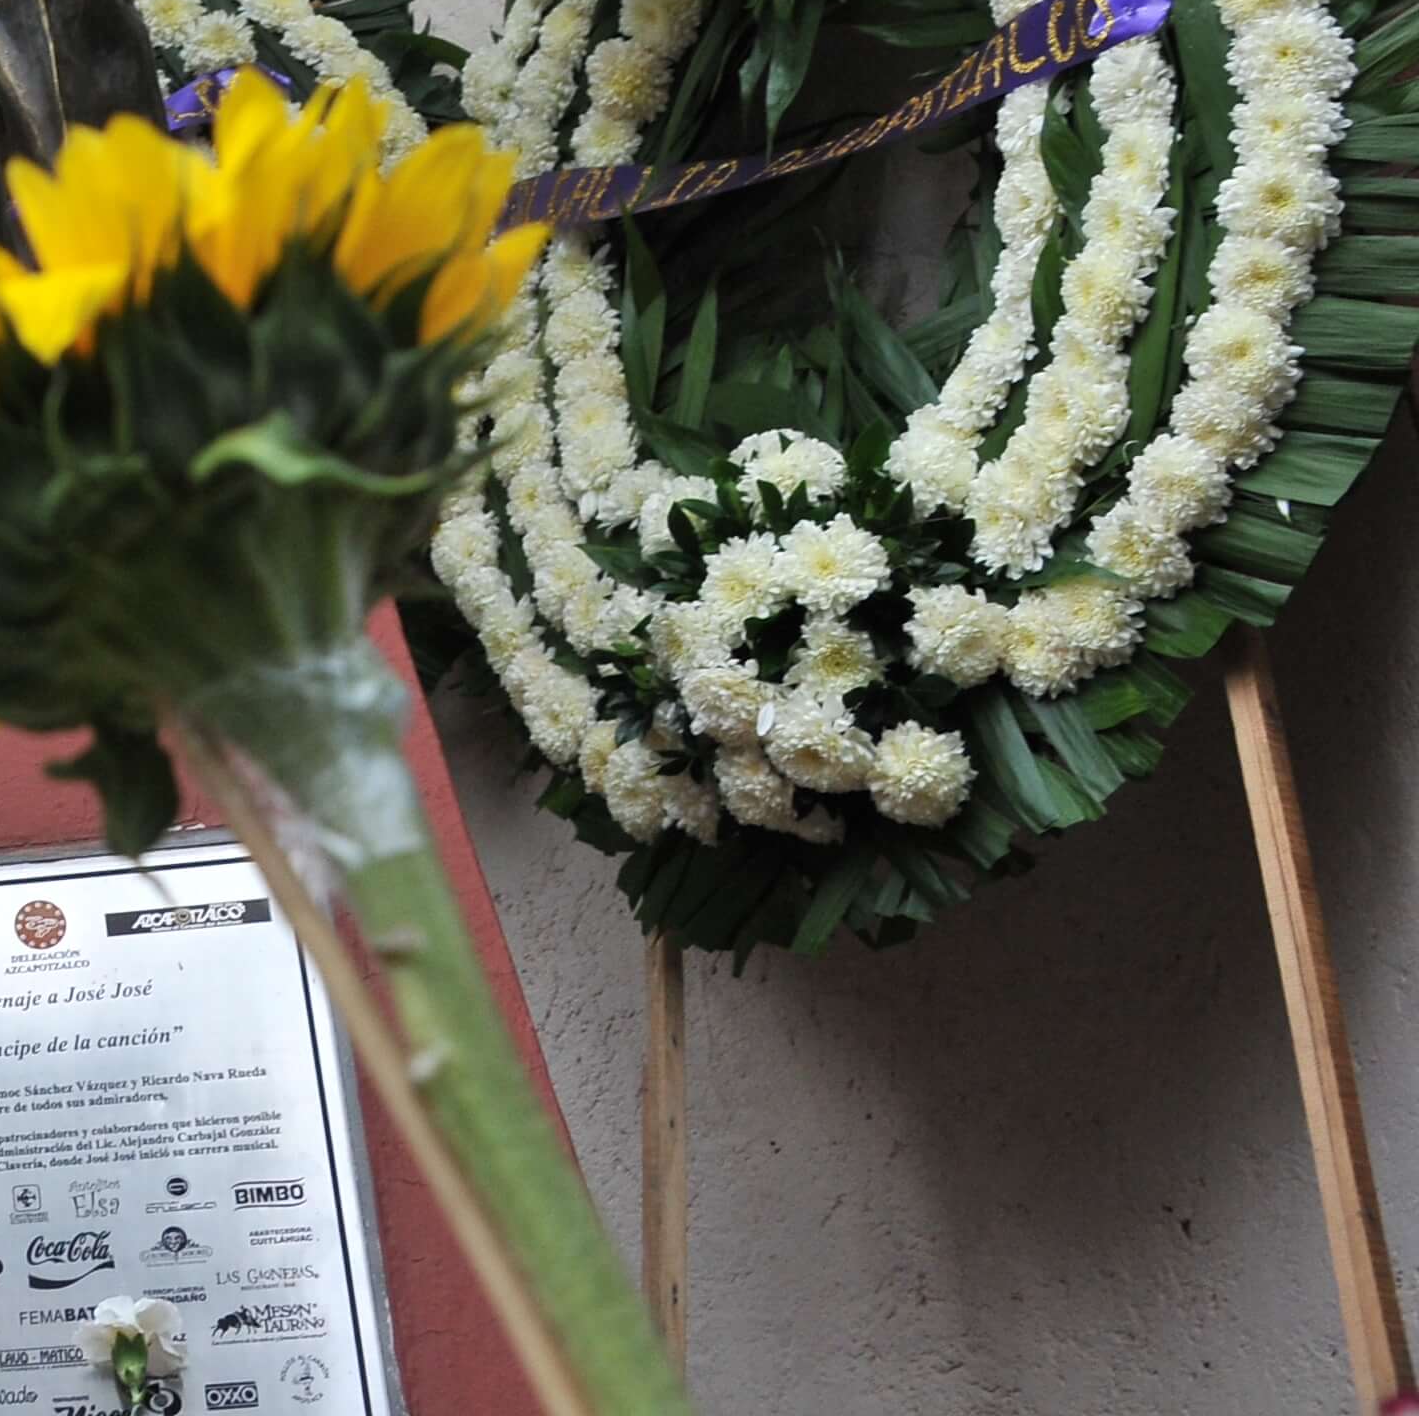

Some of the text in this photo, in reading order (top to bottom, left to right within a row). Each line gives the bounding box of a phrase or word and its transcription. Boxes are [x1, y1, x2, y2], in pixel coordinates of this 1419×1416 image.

[47, 993, 59, 1004] a
[64, 983, 106, 1004] José
[110, 979, 153, 1000] José
[46, 1036, 69, 1054] de
[73, 1034, 91, 1051] la
[24, 1083, 73, 1098] Sánchez
[76, 1080, 128, 1094] Vázquez
[130, 1078, 138, 1090] y
[141, 1072, 190, 1088] Ricardo
[193, 1070, 225, 1083] Nava
[227, 1066, 267, 1080] Rueda
[13, 1101, 28, 1113] de
[31, 1098, 64, 1112] todos
[66, 1098, 86, 1110] sus
[81, 1126, 88, 1138] y
[91, 1120, 169, 1137] colaboradores
[171, 1120, 192, 1132] que
[194, 1114, 240, 1128] hicieron
[242, 1110, 282, 1126] posible
[76, 1140, 93, 1152] del
[95, 1138, 116, 1150] Lic.
[119, 1133, 175, 1149] Alejandro
[177, 1128, 227, 1145] Carbajal
[229, 1125, 282, 1140] González
[49, 1154, 83, 1168] donde
[85, 1153, 110, 1165] José
[112, 1150, 137, 1163] José
[139, 1147, 171, 1161] inició
[172, 1147, 185, 1158] su
[188, 1143, 230, 1156] carrera
[72, 1191, 120, 1218] Elsa
[234, 1183, 304, 1205] BIMBO
[216, 1270, 241, 1285] LAS
[206, 1385, 258, 1406] OXXO
